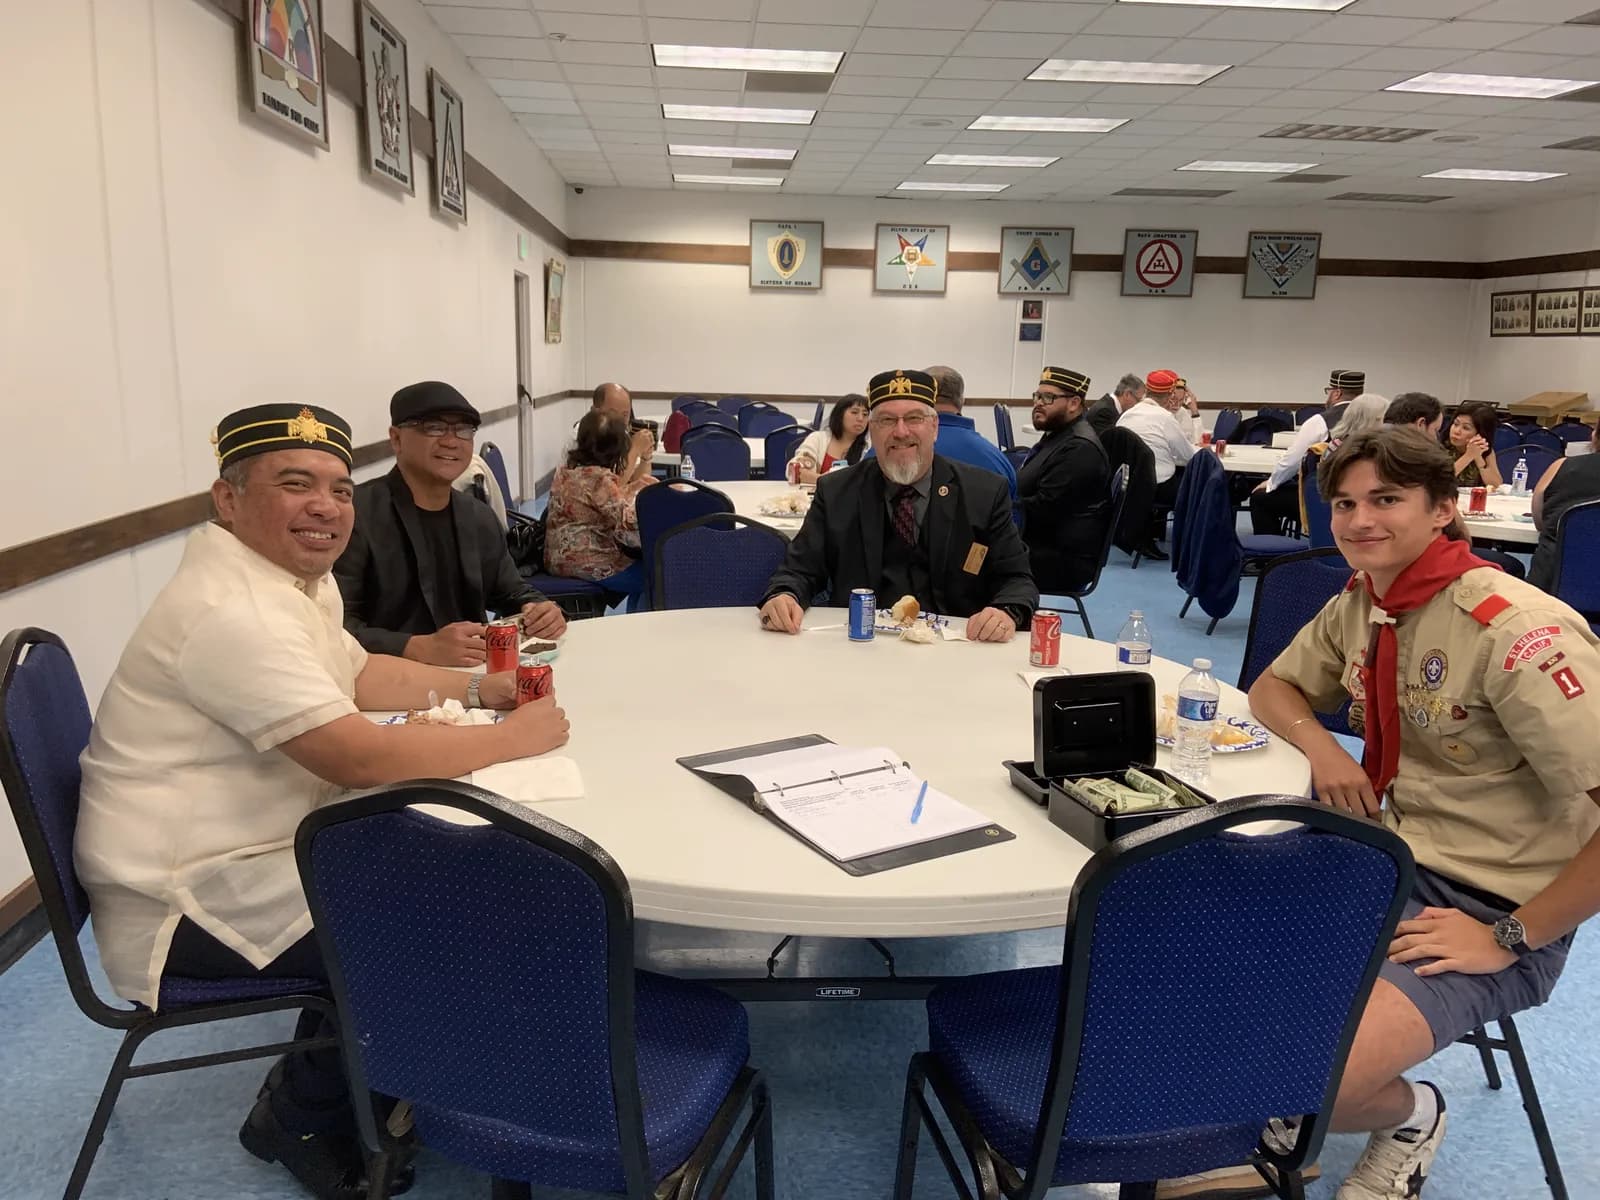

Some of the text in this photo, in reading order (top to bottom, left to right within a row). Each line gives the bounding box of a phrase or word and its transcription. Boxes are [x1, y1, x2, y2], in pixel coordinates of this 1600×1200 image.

[1518, 628, 1551, 649] HELENA
[1523, 639, 1550, 659] CALIF.
[1560, 672, 1580, 695] 1
